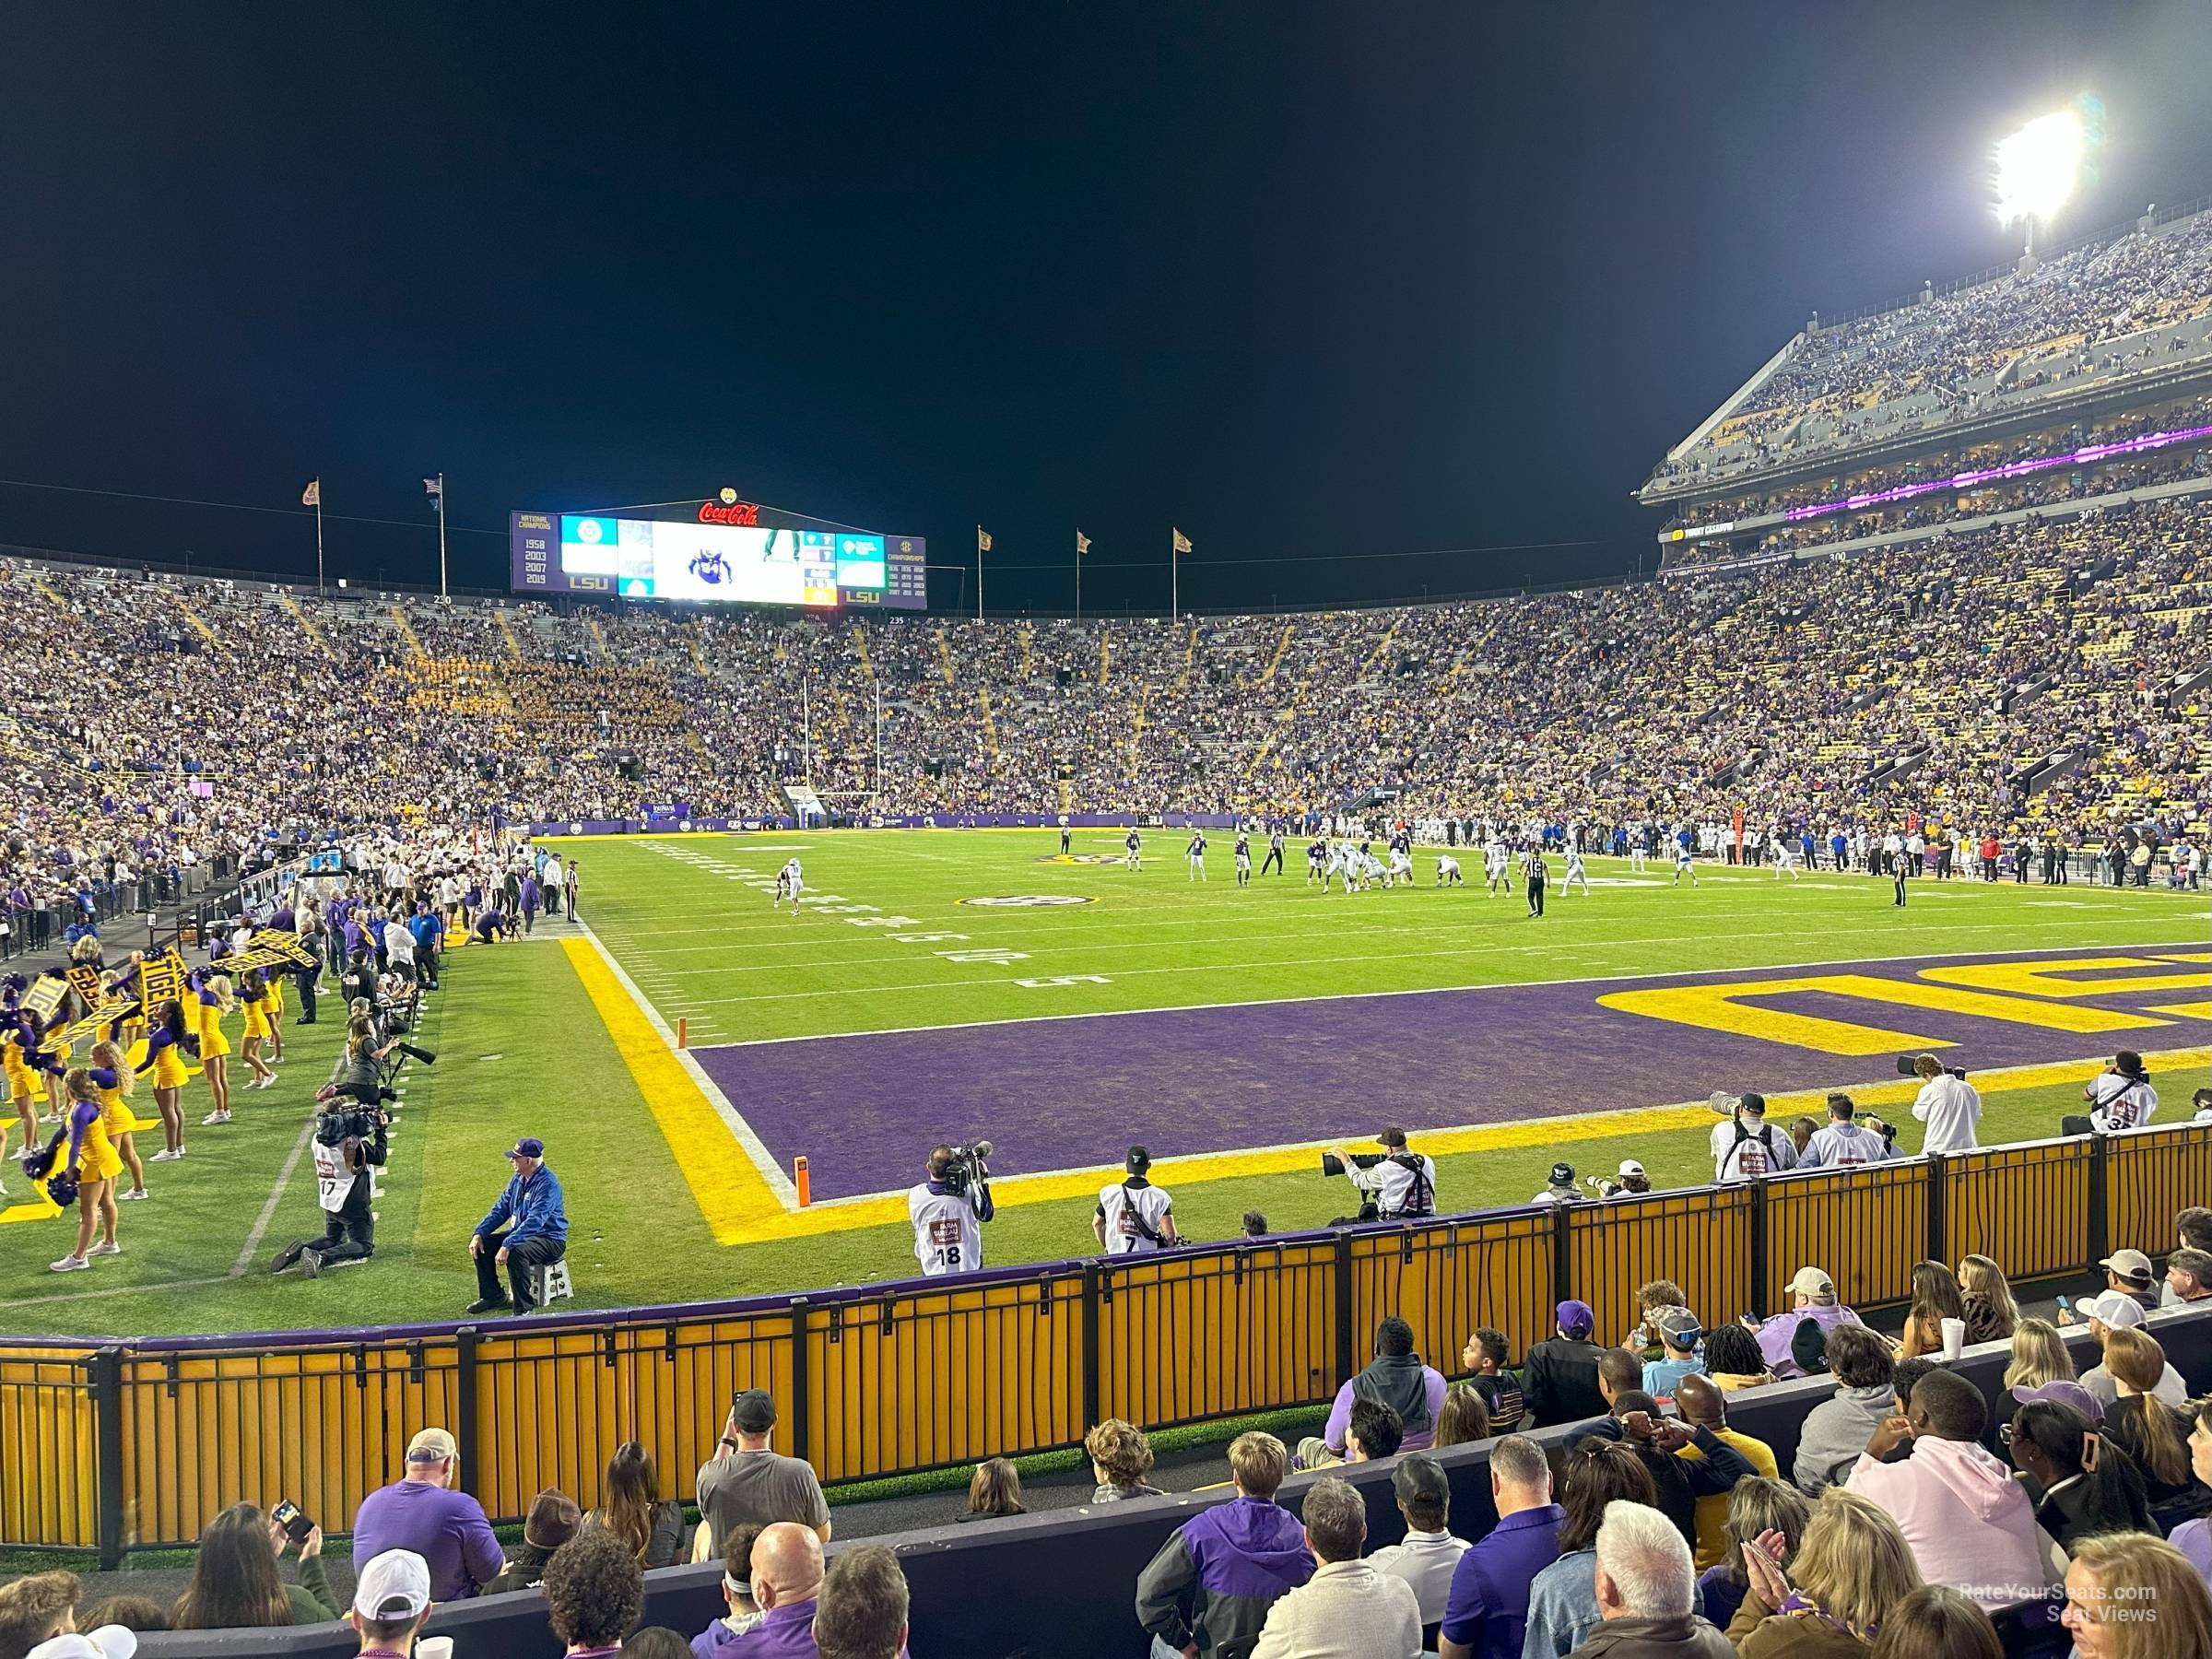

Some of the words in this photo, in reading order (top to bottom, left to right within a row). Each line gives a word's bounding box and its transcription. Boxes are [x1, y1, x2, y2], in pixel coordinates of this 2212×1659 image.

[518, 521, 551, 531] CHAMPIONS
[525, 539, 545, 549] 1958
[525, 551, 546, 561] 2003
[525, 562, 546, 572] 2007
[526, 574, 546, 584] 2019
[569, 576, 608, 590] LSU
[846, 590, 880, 604] LSU
[889, 617, 904, 625] 235
[1534, 863, 1542, 873] C
[320, 1180, 336, 1196] 17
[933, 1227, 959, 1237] BUREAU
[936, 1246, 961, 1266] 18
